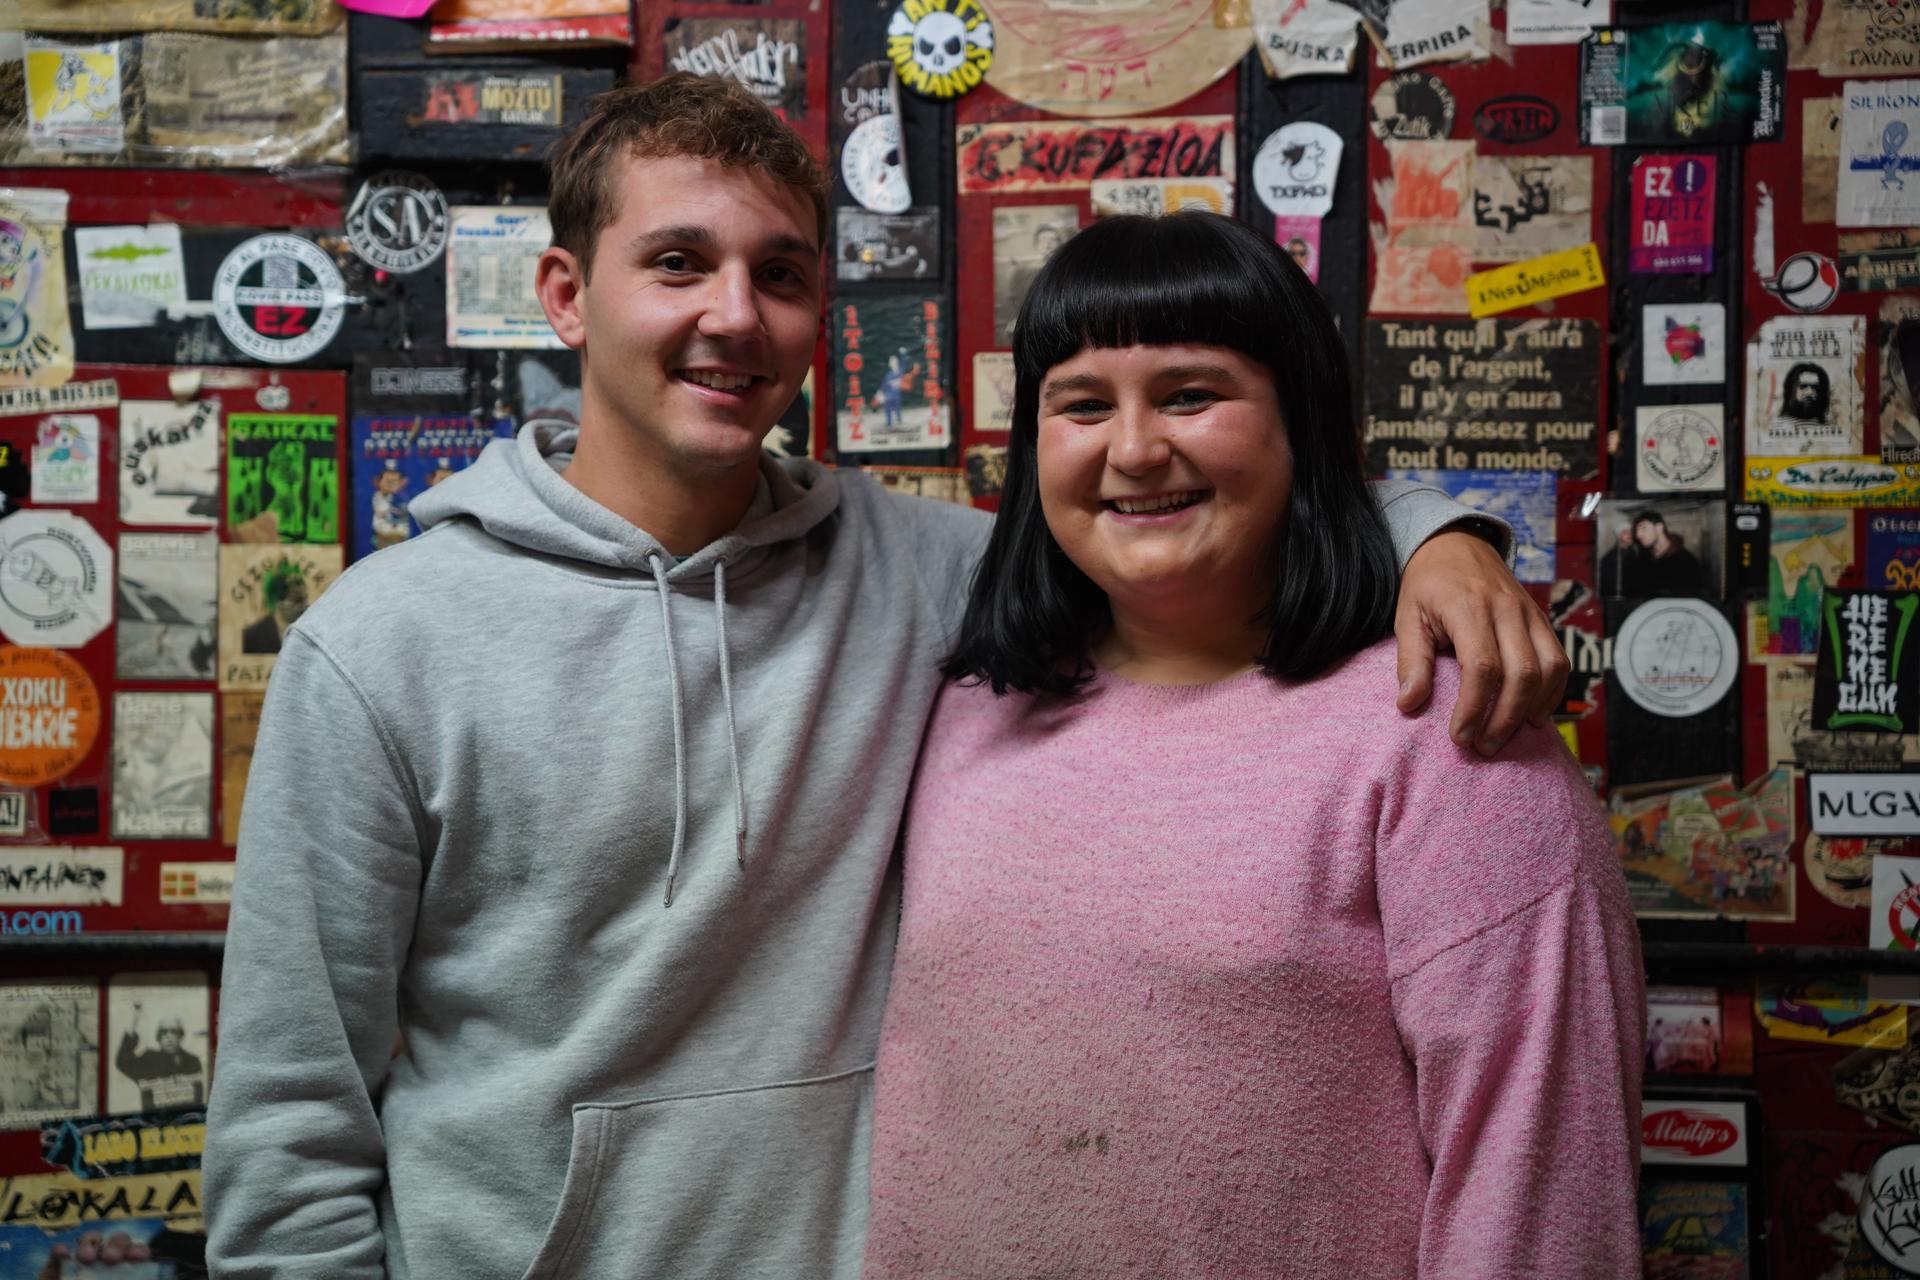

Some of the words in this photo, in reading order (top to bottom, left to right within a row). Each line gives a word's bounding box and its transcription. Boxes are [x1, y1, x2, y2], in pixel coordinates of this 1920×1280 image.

[1387, 25, 1471, 61] ERRIRA
[886, 35, 993, 98] HUMANOS
[1850, 95, 1920, 110] SILIKON
[1644, 166, 1673, 198] EZ
[1642, 219, 1670, 247] DA
[254, 306, 311, 336] EZ
[1381, 323, 1437, 348] Tant
[1503, 331, 1519, 352] y
[1526, 328, 1583, 348] aura
[1409, 354, 1442, 379] de
[1449, 354, 1552, 384] l'argent,
[1399, 385, 1414, 409] il
[1421, 386, 1457, 416] n'y
[1466, 391, 1498, 409] en
[1506, 391, 1562, 409] aura
[1366, 415, 1448, 442] jamais
[1454, 421, 1527, 440] assez
[1535, 421, 1594, 443] pour
[128, 401, 212, 487] euskaraz
[1387, 447, 1438, 469] tout
[1445, 446, 1468, 469] le
[1476, 446, 1571, 470] monde.
[227, 665, 270, 683] PAT
[0, 677, 67, 705] XOKU
[0, 707, 78, 748] IBRE
[1818, 789, 1920, 818] MUGA
[0, 861, 107, 892] ONTAINER
[0, 909, 83, 935] .com
